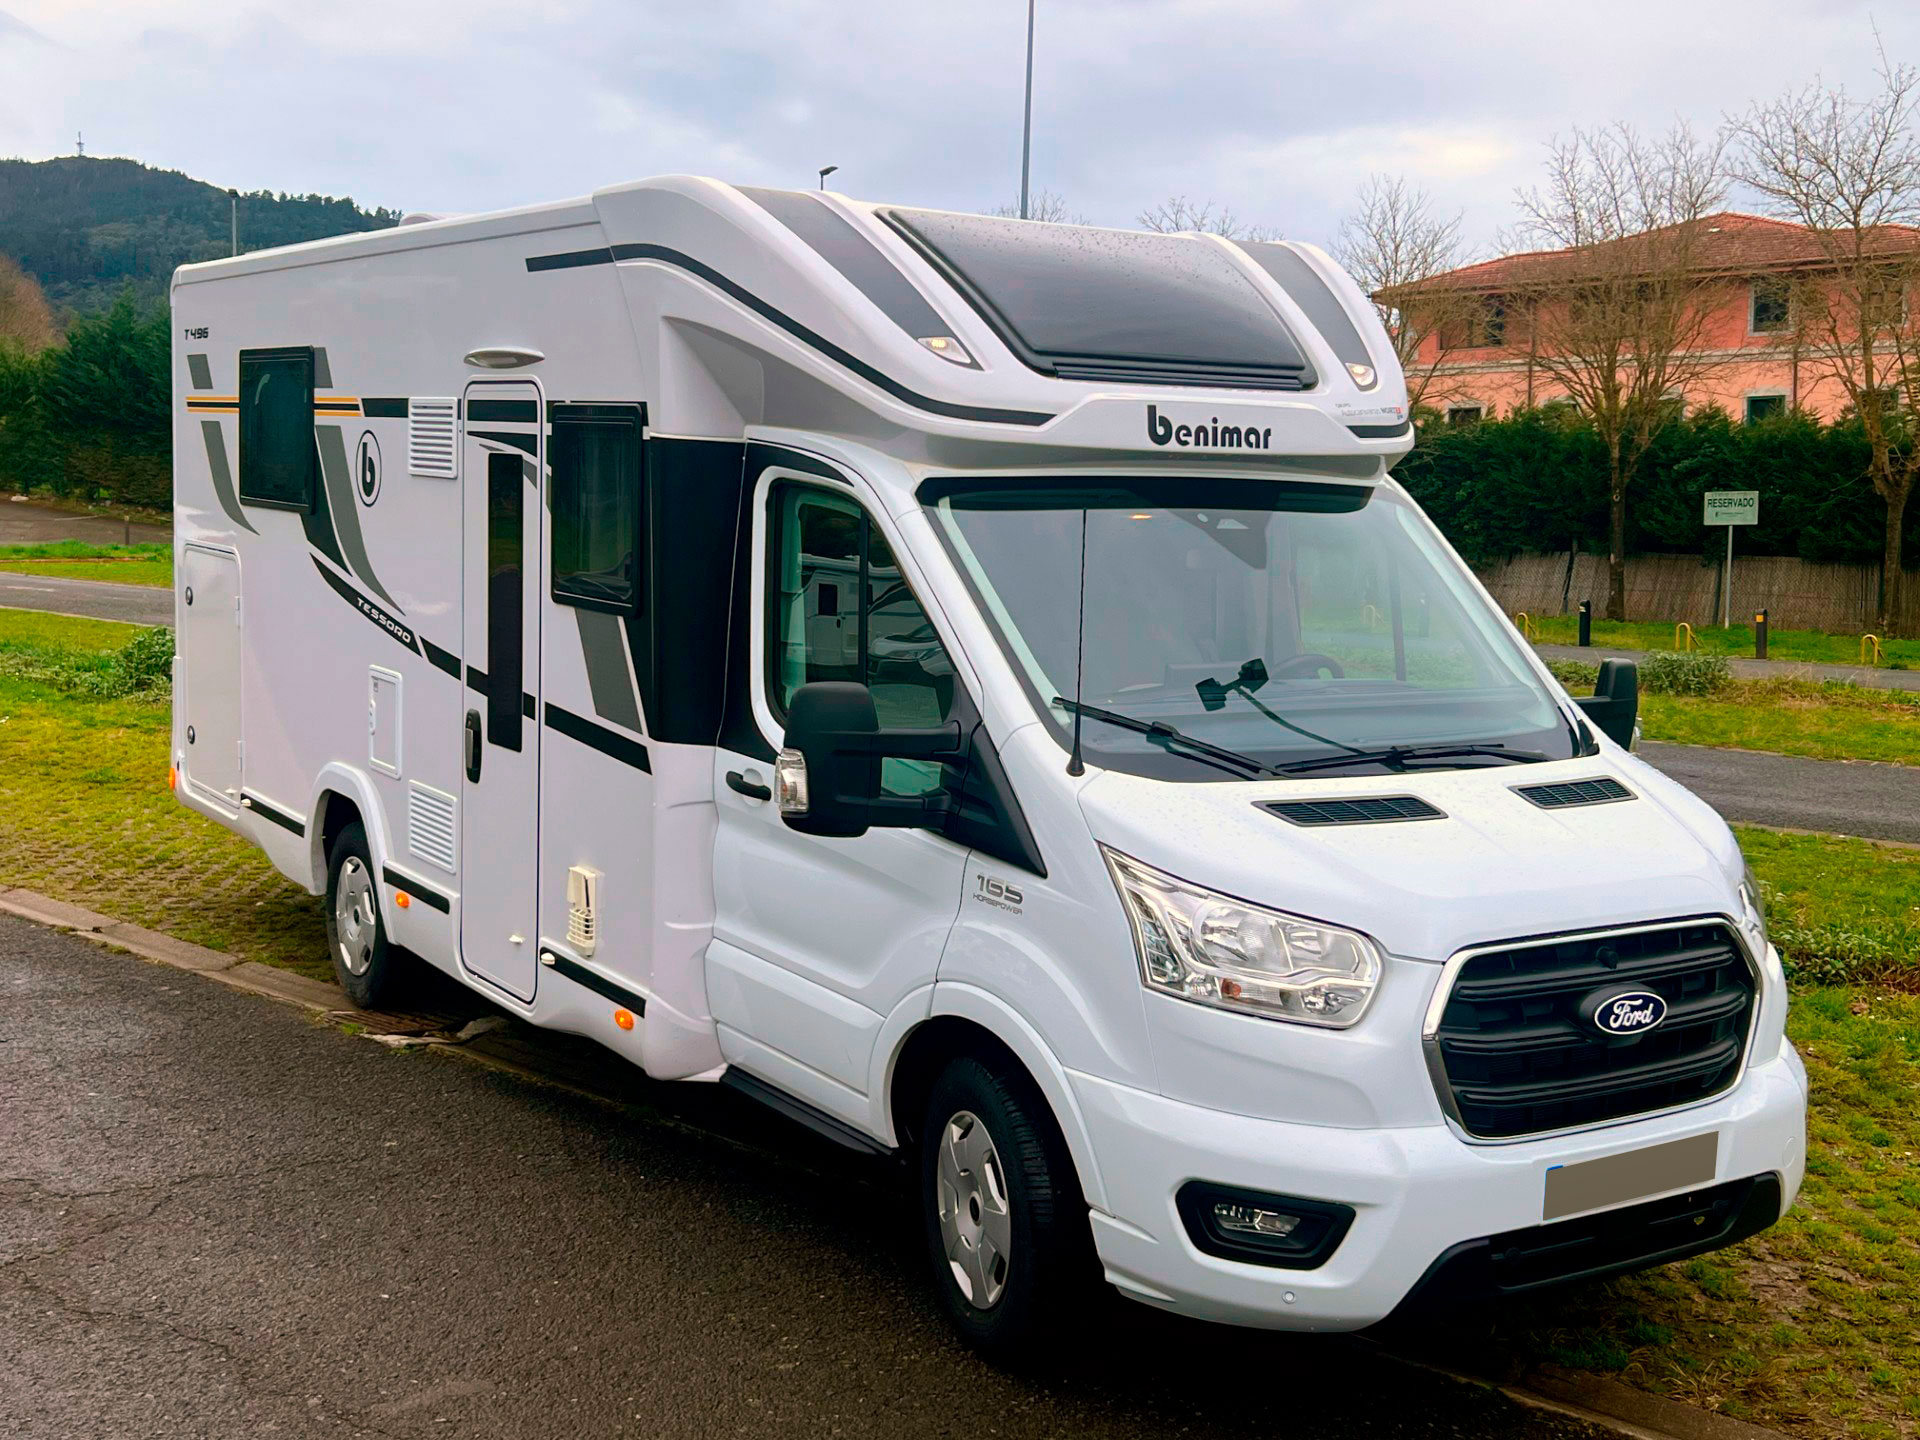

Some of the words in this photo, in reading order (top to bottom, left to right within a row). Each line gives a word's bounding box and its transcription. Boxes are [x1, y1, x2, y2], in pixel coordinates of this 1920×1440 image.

[184, 327, 209, 341] T496
[1147, 404, 1272, 449] benimar
[1707, 497, 1755, 508] RESERVADO
[357, 597, 411, 643] TESSORO
[977, 874, 1023, 905] 165
[1609, 998, 1655, 1029] Ford
